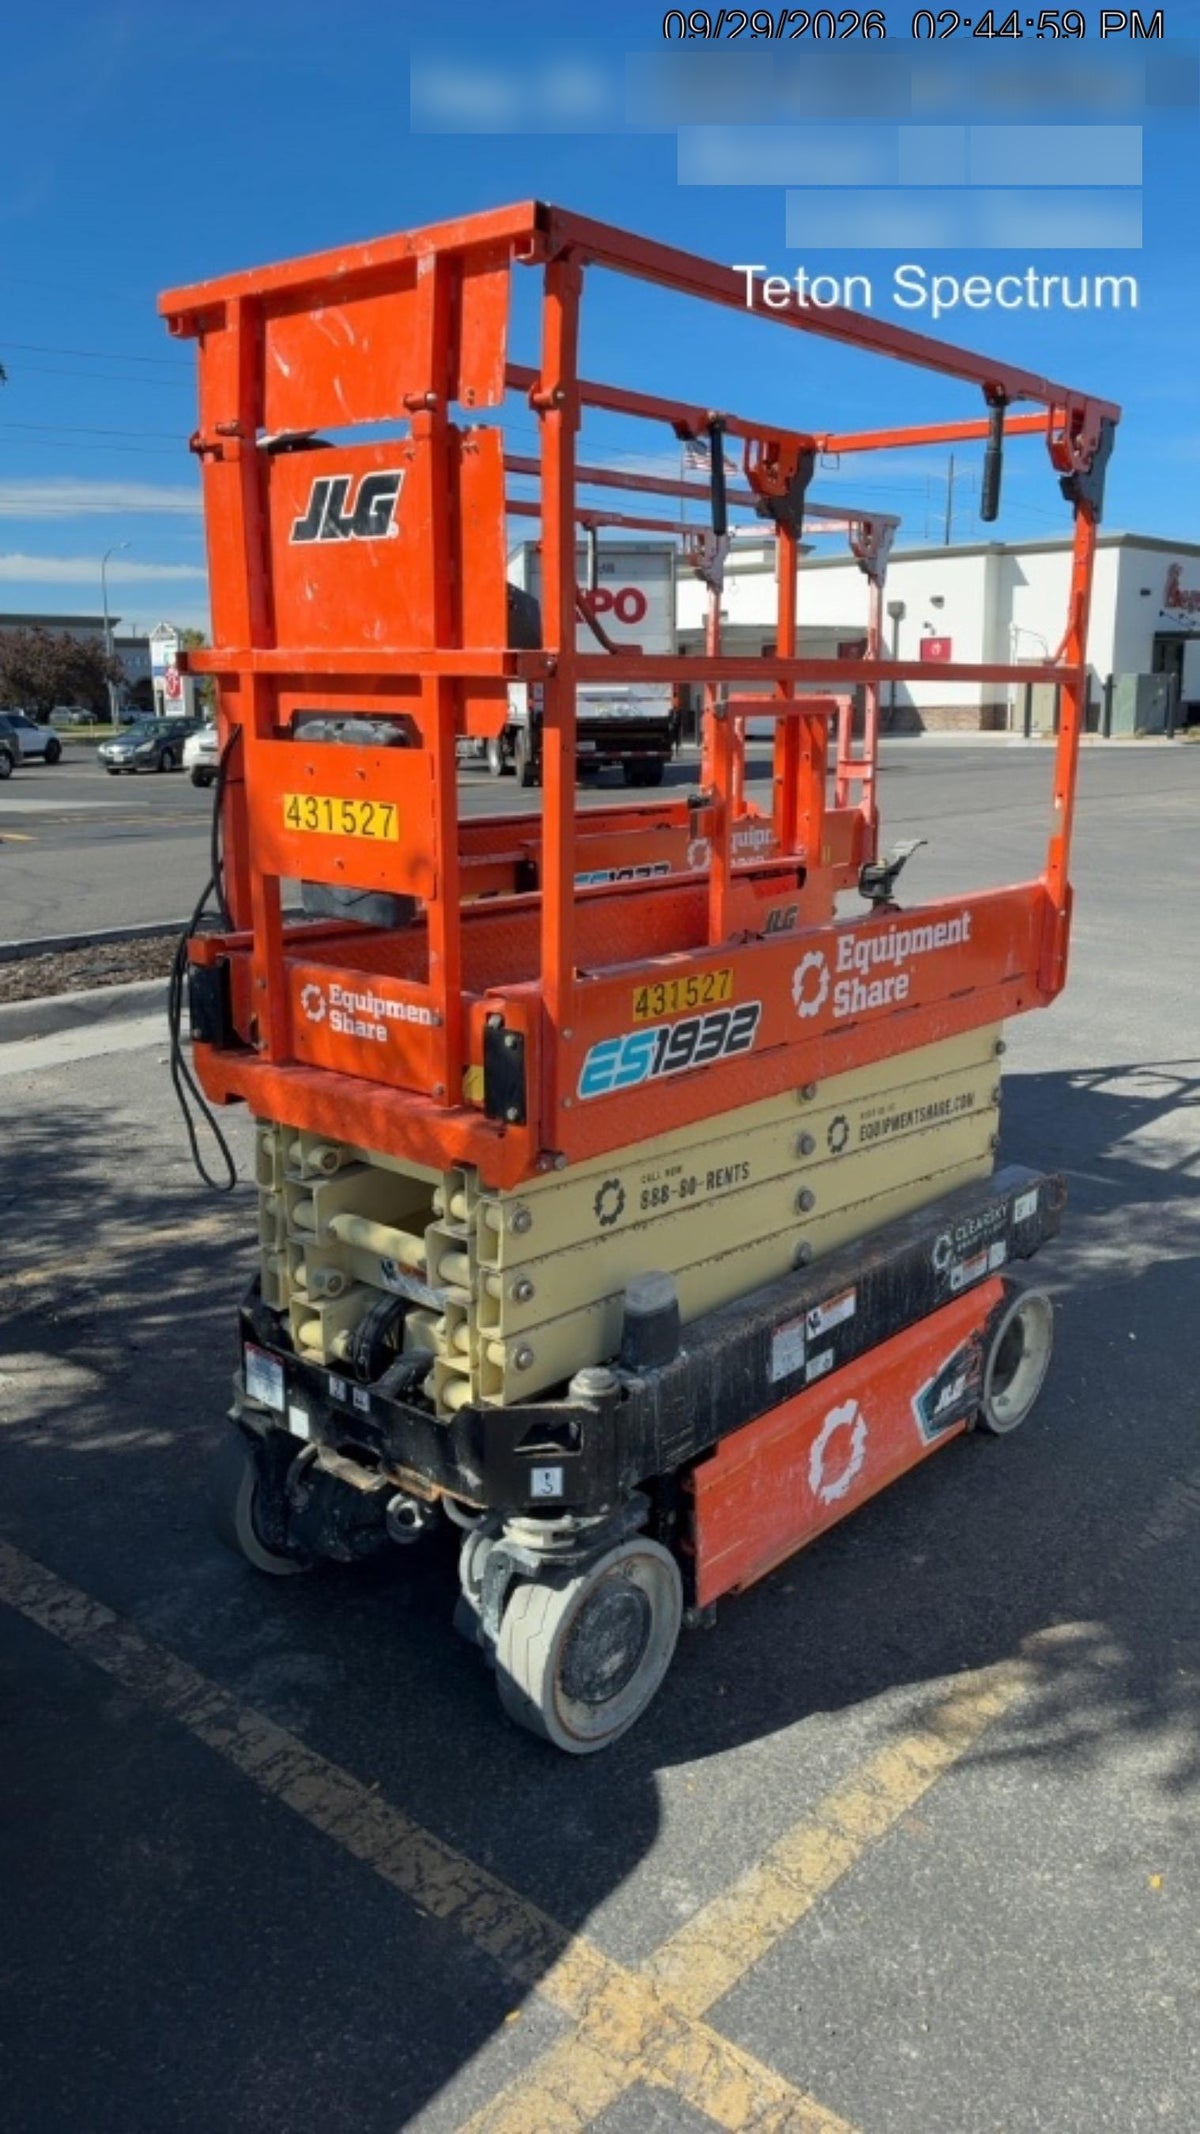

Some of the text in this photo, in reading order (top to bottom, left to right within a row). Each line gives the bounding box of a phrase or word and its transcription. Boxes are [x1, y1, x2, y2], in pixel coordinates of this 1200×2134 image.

[289, 468, 406, 545] JLG
[576, 587, 648, 625] PO
[286, 796, 394, 838] 431527
[836, 911, 972, 975] Equipment
[328, 983, 442, 1027] Equipmen
[635, 969, 730, 1017] 431527
[832, 973, 910, 1018] Share
[329, 1009, 388, 1042] Share
[577, 1000, 762, 1100] ES1932
